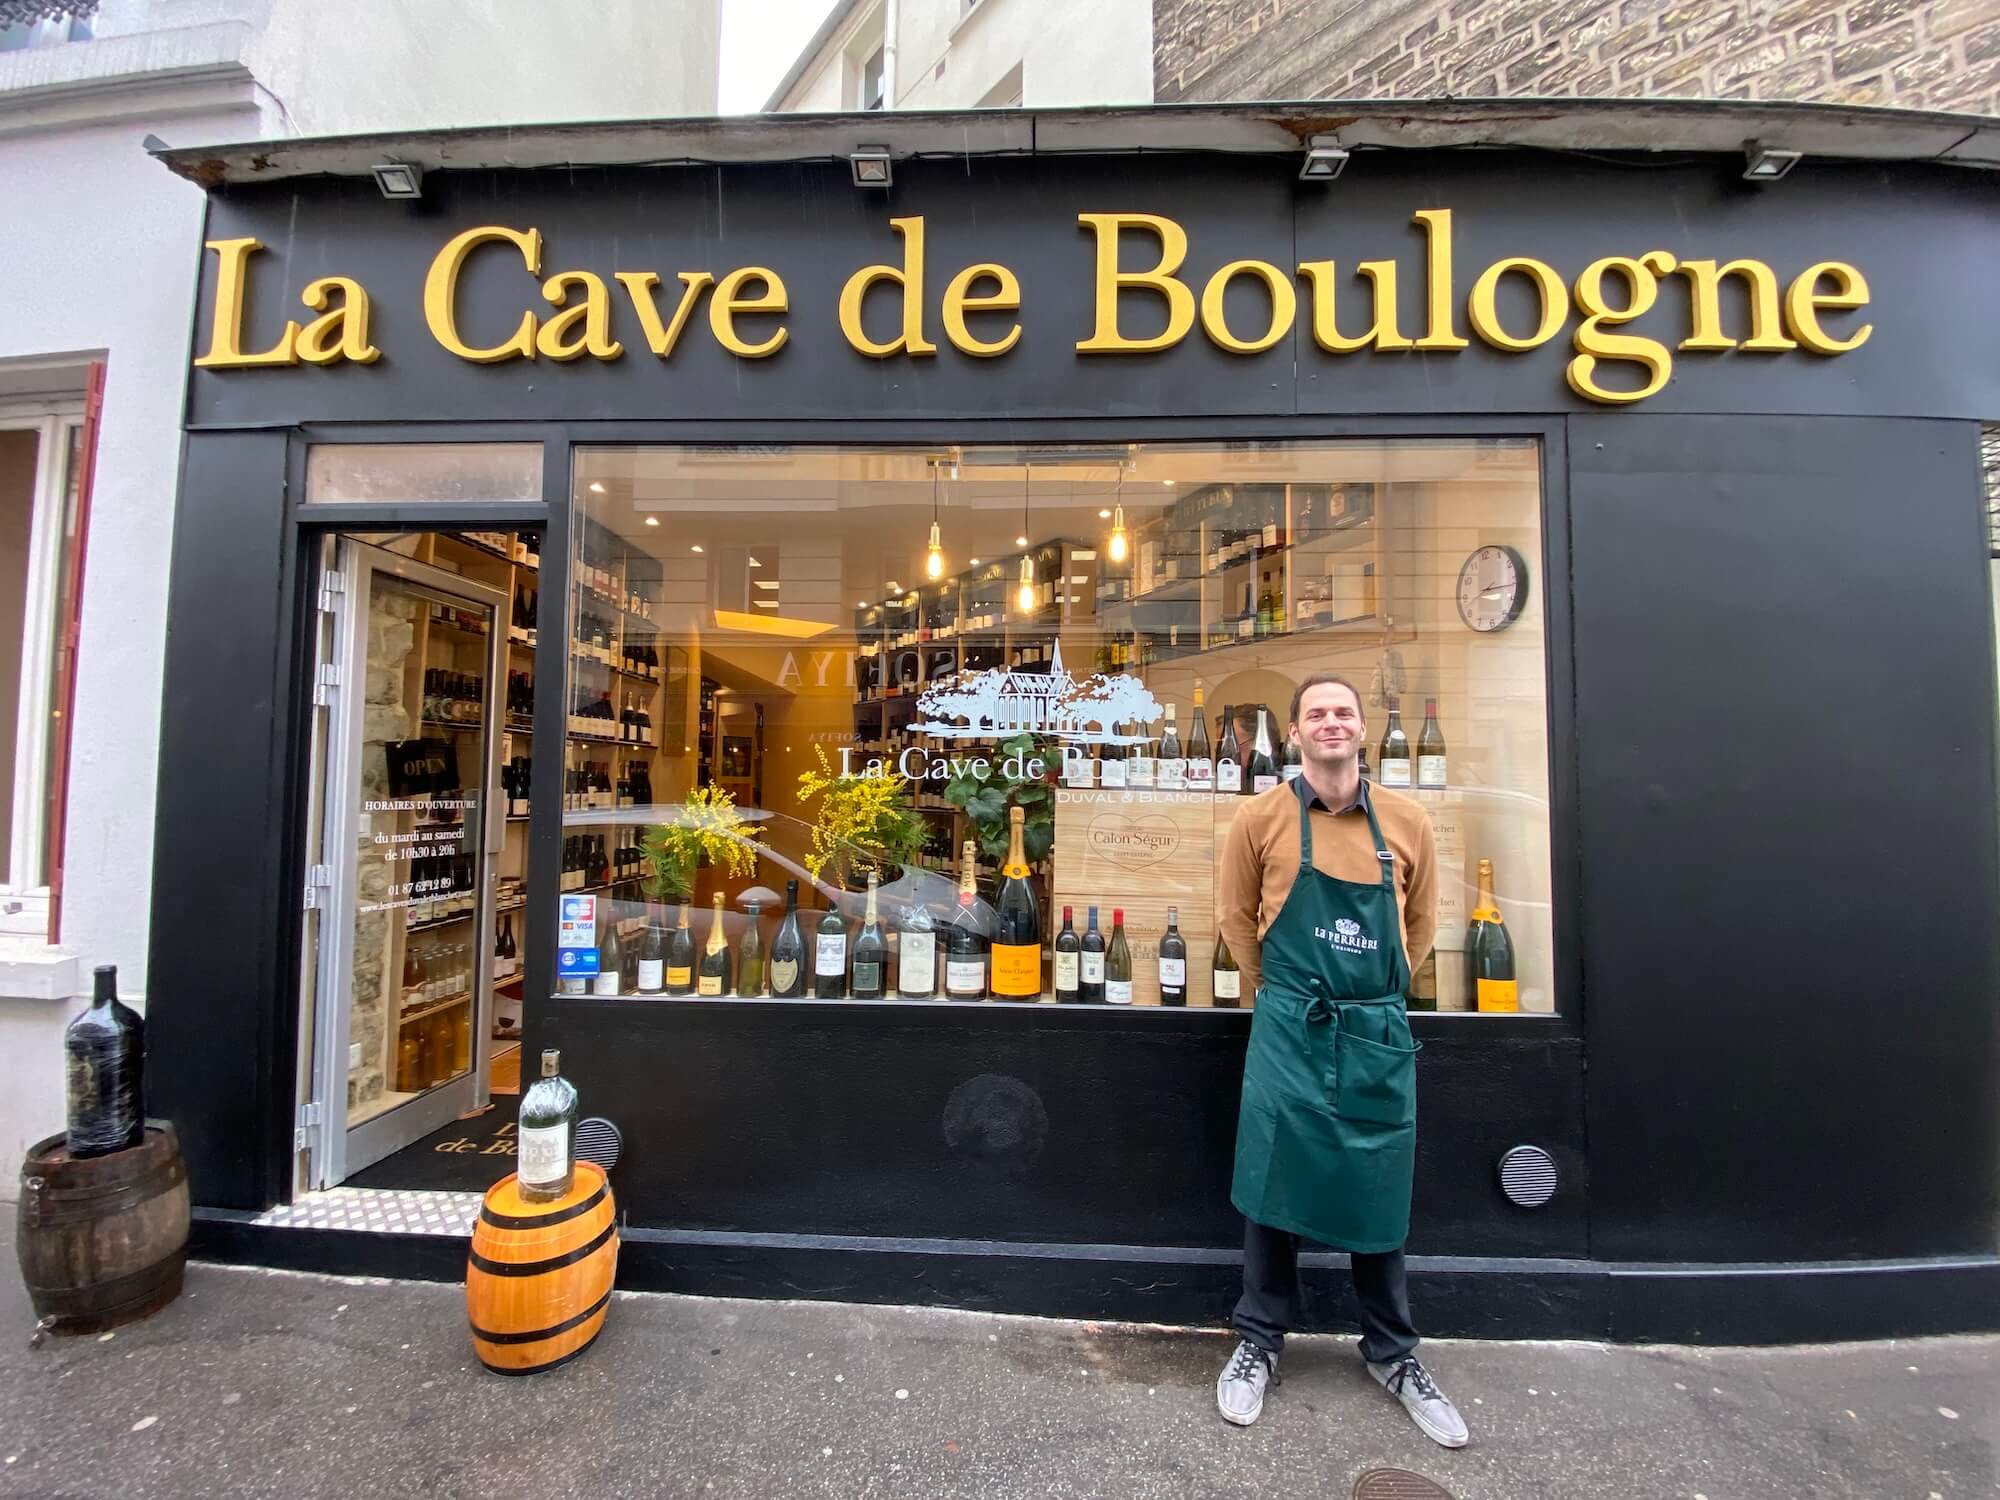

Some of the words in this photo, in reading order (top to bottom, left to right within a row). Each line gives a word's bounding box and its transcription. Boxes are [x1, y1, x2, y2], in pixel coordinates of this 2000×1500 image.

[196, 237, 382, 369] La
[422, 225, 790, 361] Cave
[838, 215, 1022, 357] de
[1075, 207, 1871, 404] Boulogne
[837, 747, 883, 781] La
[899, 746, 989, 781] Cave
[1002, 746, 1045, 780] de
[365, 800, 415, 811] HORAIRES
[417, 799, 477, 810] D'OUVERTURE
[1057, 791, 1119, 804] DUVAL
[1139, 792, 1237, 805] BLANCHET
[375, 832, 389, 844] du
[391, 830, 420, 843] mardi
[421, 832, 433, 841] au
[434, 827, 465, 840] samedi
[384, 849, 398, 861] de
[400, 846, 430, 860] 10h30
[438, 844, 456, 857] 20h
[388, 885, 399, 896] 01
[402, 882, 414, 894] 87
[435, 1137, 477, 1153] de
